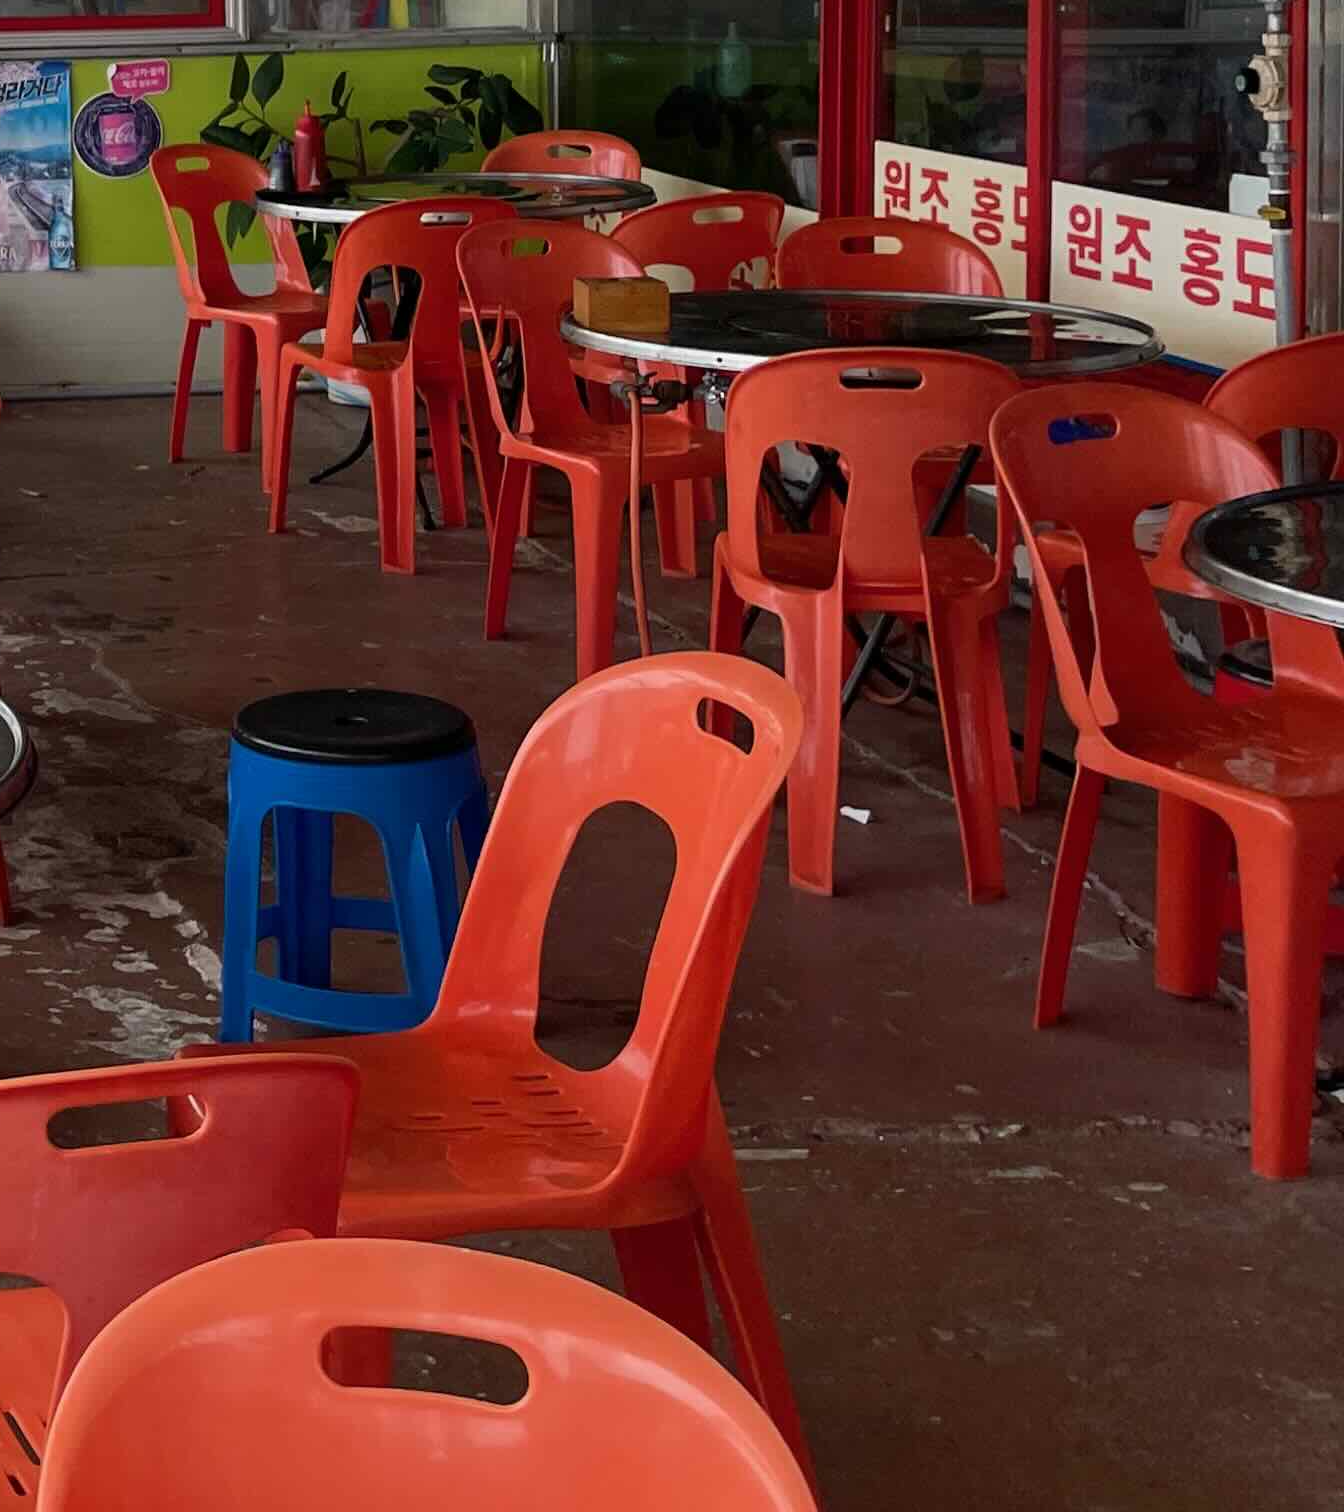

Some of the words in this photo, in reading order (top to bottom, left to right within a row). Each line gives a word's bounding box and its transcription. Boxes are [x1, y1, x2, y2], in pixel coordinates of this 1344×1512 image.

[884, 160, 951, 232] 원조
[1067, 204, 1153, 292] 원조
[1180, 226, 1277, 321] 홍도
